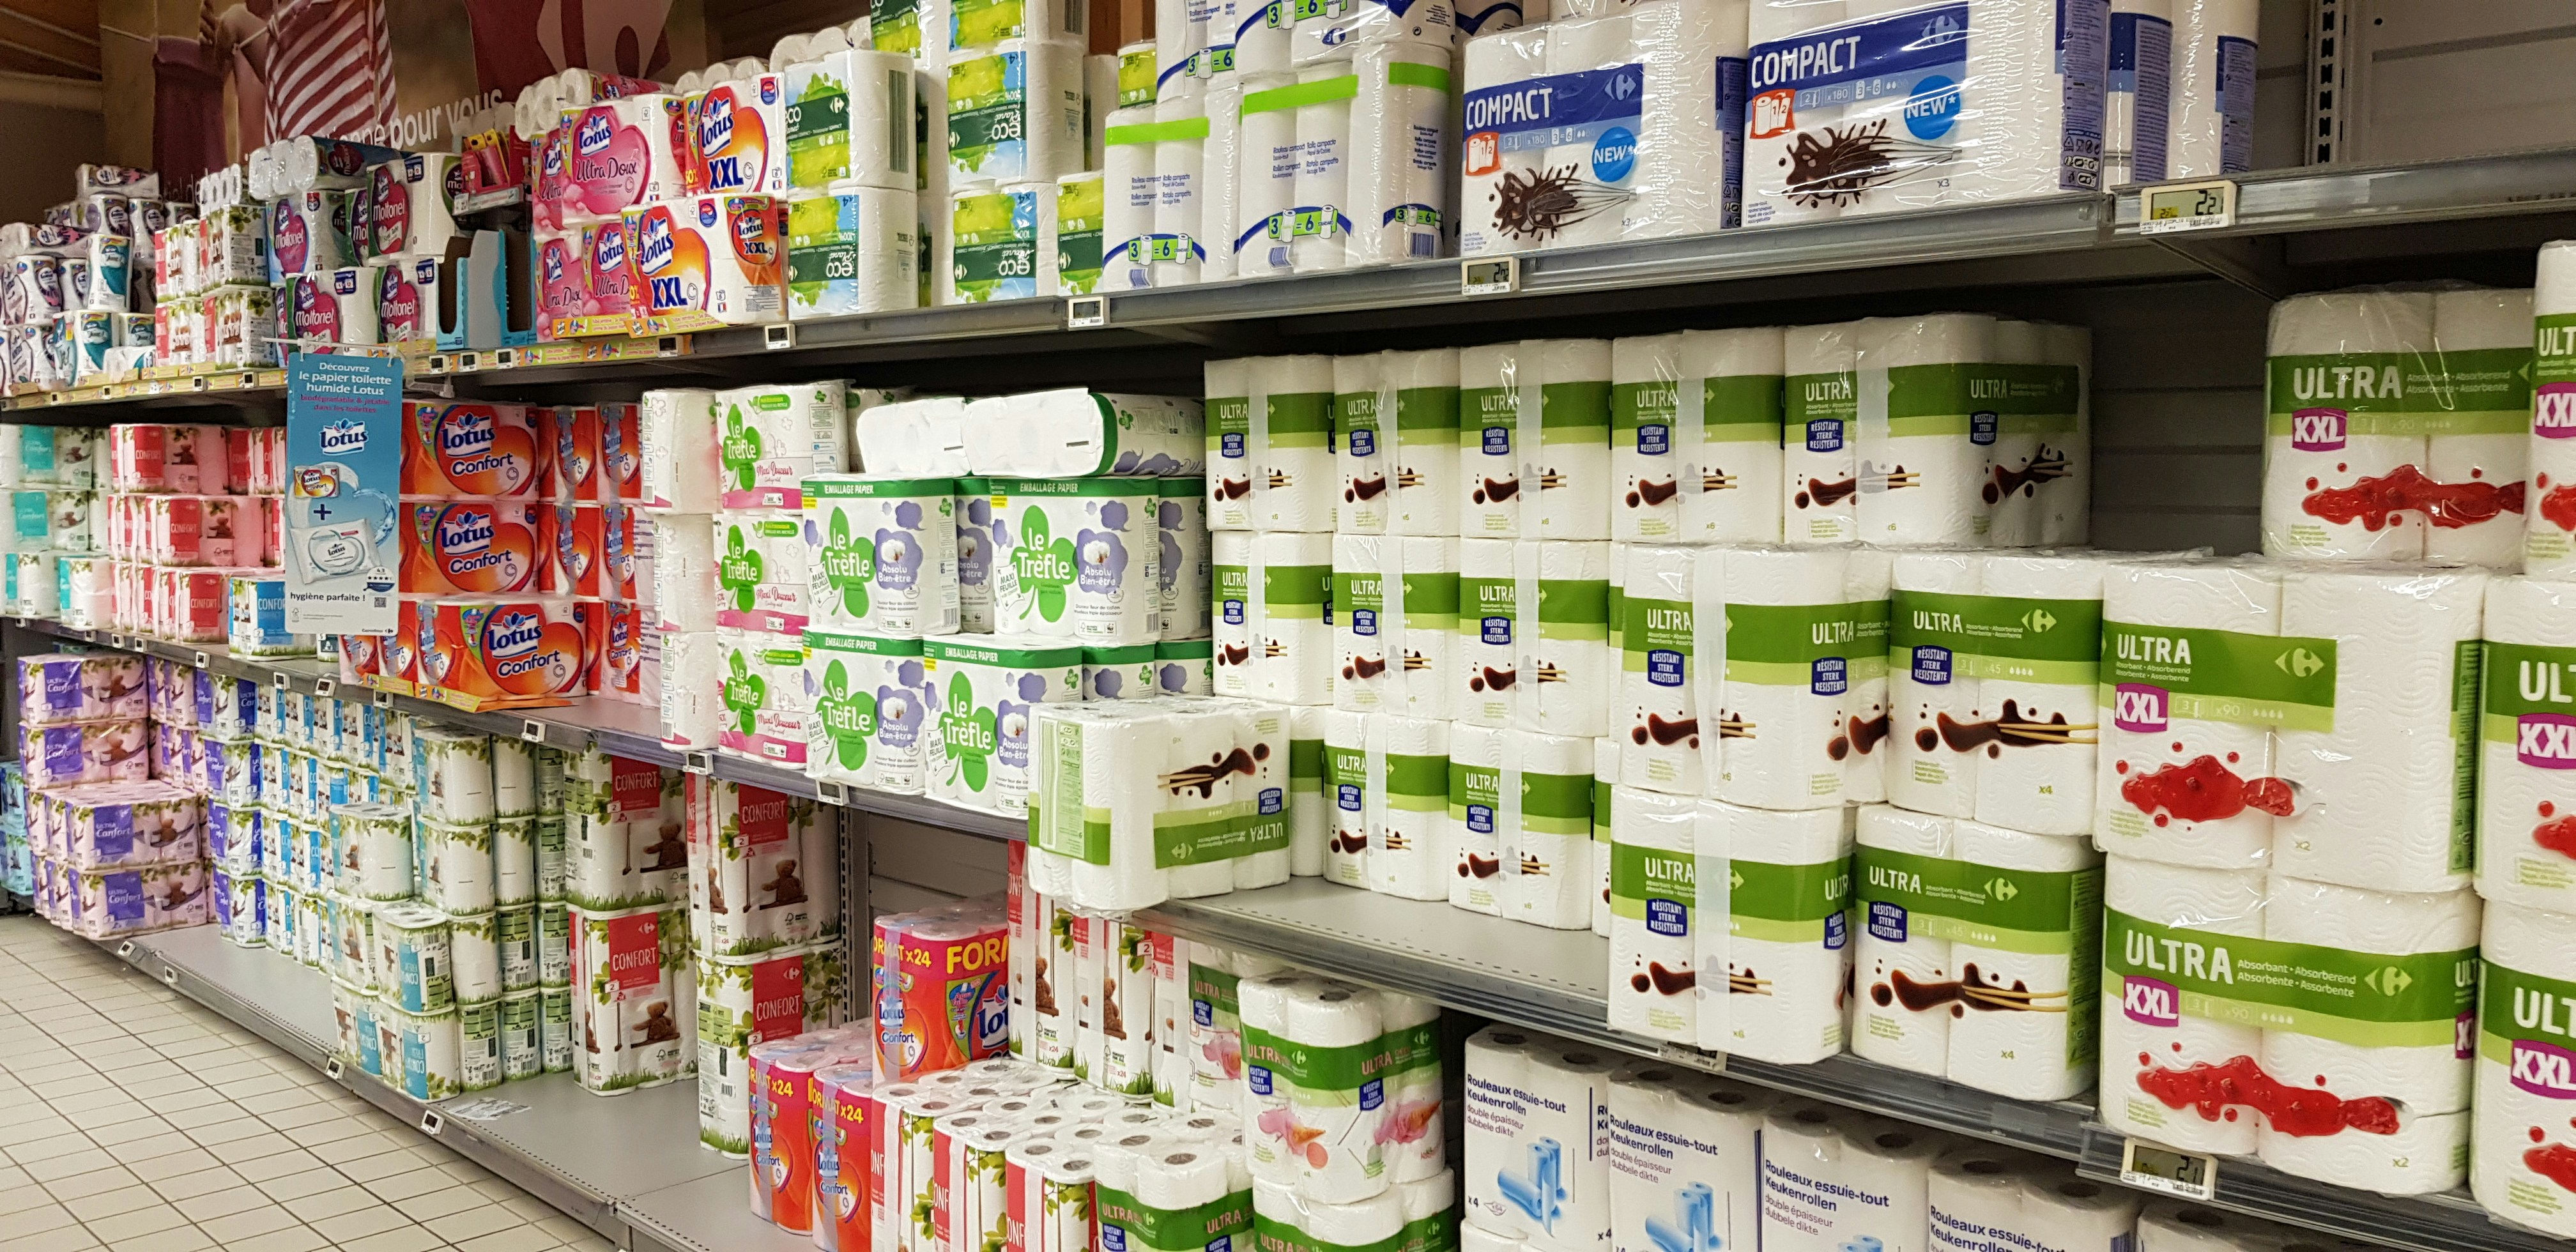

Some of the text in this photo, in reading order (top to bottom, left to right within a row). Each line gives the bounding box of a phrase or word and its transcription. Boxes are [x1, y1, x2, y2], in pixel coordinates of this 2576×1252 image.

[1752, 35, 1861, 88] COMPACT
[1466, 88, 1553, 130] COMPACT
[390, 106, 441, 150] pour
[579, 125, 612, 149] lotus
[702, 112, 734, 149] lotus
[993, 122, 1021, 141] eco
[576, 155, 637, 181] Ultra Doux
[709, 156, 744, 190] XXL
[373, 200, 405, 222] moltonel
[738, 224, 763, 236] lotus
[1271, 213, 1313, 235] 3 6
[597, 242, 625, 266] lotus
[640, 231, 675, 263] lotus
[745, 242, 767, 254] XXL
[1131, 241, 1169, 257] 3 6
[827, 260, 854, 277] eco
[999, 260, 1029, 275] eco
[652, 277, 687, 309] XXL
[295, 309, 334, 327] moltonel
[381, 302, 415, 317] moltonel
[319, 363, 370, 372] Découvrez
[299, 371, 392, 385] le papier toilette
[2293, 365, 2402, 400] ULTRA
[307, 383, 384, 395] humide Lotus
[1806, 382, 1851, 401] ULTRA
[1970, 379, 2007, 399] ULTRA
[1347, 400, 1376, 416] ULTRA
[1481, 395, 1515, 411] ULTRA
[1636, 390, 1676, 408] ULTRA
[1810, 420, 1839, 433] RÉSISTANT
[2294, 416, 2345, 443] XXL
[319, 431, 368, 447] lotus
[1809, 439, 1840, 450] RESISTENTE
[136, 450, 161, 460] CONFORT
[452, 454, 512, 476] Confort
[825, 485, 873, 494] EMBALLAGE PAPIER
[1020, 484, 1078, 492] EMBALLAGE PAPIER
[171, 523, 197, 533] CONFORT
[833, 528, 845, 550] le
[1029, 528, 1044, 551] le
[328, 546, 346, 556] lotus
[450, 550, 512, 573] Confort
[724, 560, 758, 581] Trèfle
[826, 552, 869, 577] Trèfle
[882, 564, 907, 573] Absolu
[1017, 553, 1070, 579] Trèfle
[1085, 566, 1112, 576] Absolu
[878, 572, 911, 583] Bien-être
[1080, 575, 1116, 585] Bien-être
[1222, 572, 1247, 586] ULTRA
[290, 592, 324, 602] hygiène
[327, 593, 360, 602] parfaite
[1351, 580, 1383, 595] ULTRA
[1480, 586, 1515, 602] ULTRA
[191, 598, 217, 609] CONFORT
[1647, 608, 1692, 631] ULTRA
[1913, 611, 1963, 634] ULTRA
[1812, 621, 1854, 645] ULTRA
[825, 637, 877, 650] EMBALLAGE PAPIER
[2117, 634, 2191, 665] ULTRA
[1917, 647, 1947, 660] RÉSISTANT
[498, 650, 560, 677] Confort
[1922, 659, 1941, 669] STERK
[2147, 664, 2191, 674] Absorberend
[1915, 668, 1948, 682] RESISTENTE
[2151, 673, 2189, 682] Assorbente
[47, 682, 79, 692] Confort
[830, 680, 844, 701] le
[823, 701, 870, 731] Trèfle
[2115, 691, 2167, 726] XXL
[879, 728, 912, 740] Bien-être
[882, 720, 908, 731] Absolu
[1337, 754, 1367, 772] ULTRA
[615, 772, 657, 791] CONFORT
[1466, 772, 1499, 791] ULTRA
[2039, 785, 2052, 795] x4
[742, 800, 785, 823] CONFORT
[96, 827, 130, 837] Confort
[1644, 857, 1695, 883] ULTRA
[1869, 866, 1921, 894] ULTRA
[109, 893, 140, 903] Confort
[1873, 904, 1903, 919] RÉSISTANT
[1878, 915, 1896, 927] STERK
[1871, 925, 1903, 940] RESISTENTE
[613, 947, 656, 971] CONFORT
[907, 950, 931, 968] x24
[2126, 930, 2234, 984] ULTRA
[2238, 959, 2356, 985] Absorbant Absorberend
[2237, 971, 2355, 997] Absorbente Assorbente
[756, 995, 799, 1021] CONFORT
[2124, 983, 2178, 1019] XXL
[882, 1032, 914, 1044] Confort
[1361, 1054, 1392, 1074] ULTRA
[2001, 1050, 2014, 1060] x4
[772, 1080, 793, 1097] x24
[1468, 1074, 1567, 1113] Rouleaux essuie-tout
[1467, 1088, 1526, 1116] Keukenrollen
[840, 1105, 864, 1123] x24
[1467, 1104, 1524, 1130] double épaisseur
[1467, 1117, 1514, 1137] dubbele dikte
[1610, 1114, 1718, 1155] Rouleaux essuie-tout
[1610, 1129, 1673, 1159] Keukenrollen
[1611, 1148, 1672, 1175] double épaisseur
[1611, 1159, 1659, 1183] dubbele dikte
[2393, 1157, 2409, 1168] x2
[821, 1182, 848, 1196] Confort
[1765, 1159, 1889, 1207] Rouleaux essuie-tout
[1765, 1177, 1837, 1212] Keukenrollen
[1765, 1194, 1833, 1228] double épaisseur
[1208, 1211, 1241, 1233] ULTRA
[1765, 1207, 1819, 1235] dubbele dikte
